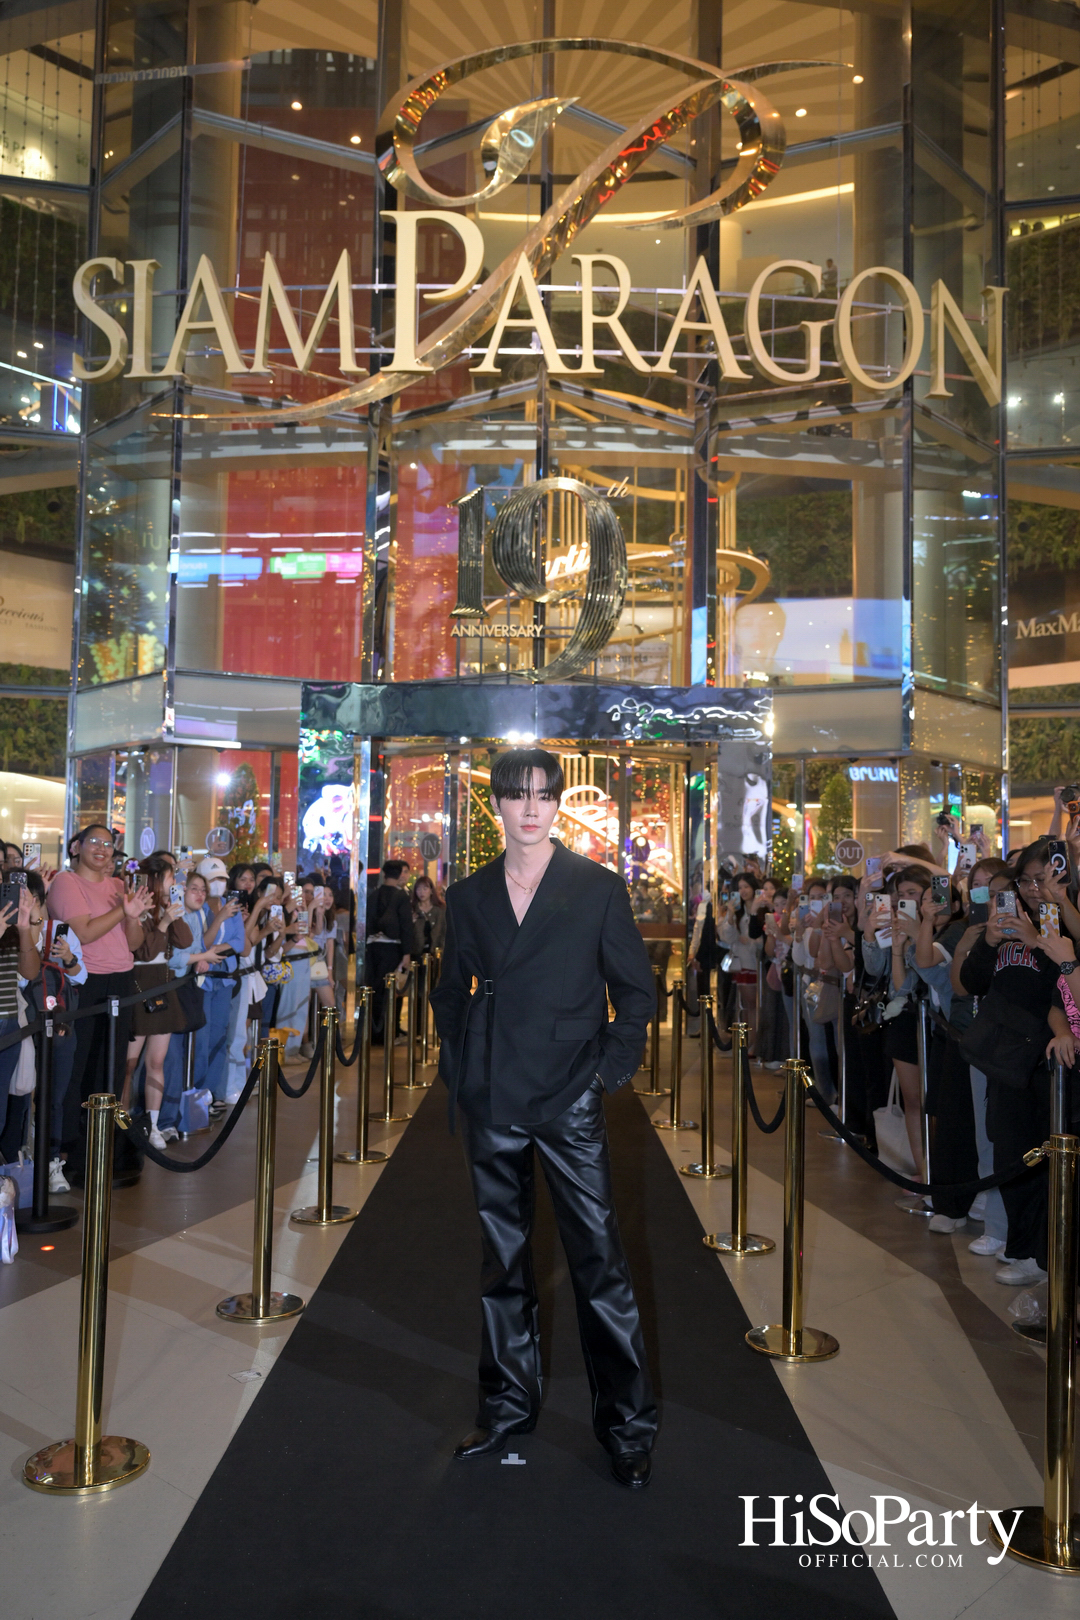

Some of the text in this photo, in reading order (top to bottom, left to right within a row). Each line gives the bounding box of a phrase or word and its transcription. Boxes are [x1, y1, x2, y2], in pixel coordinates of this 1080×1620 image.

[450, 624, 544, 638] ANNIVERSARY
[424, 839, 438, 856] IN
[837, 847, 862, 860] OUT
